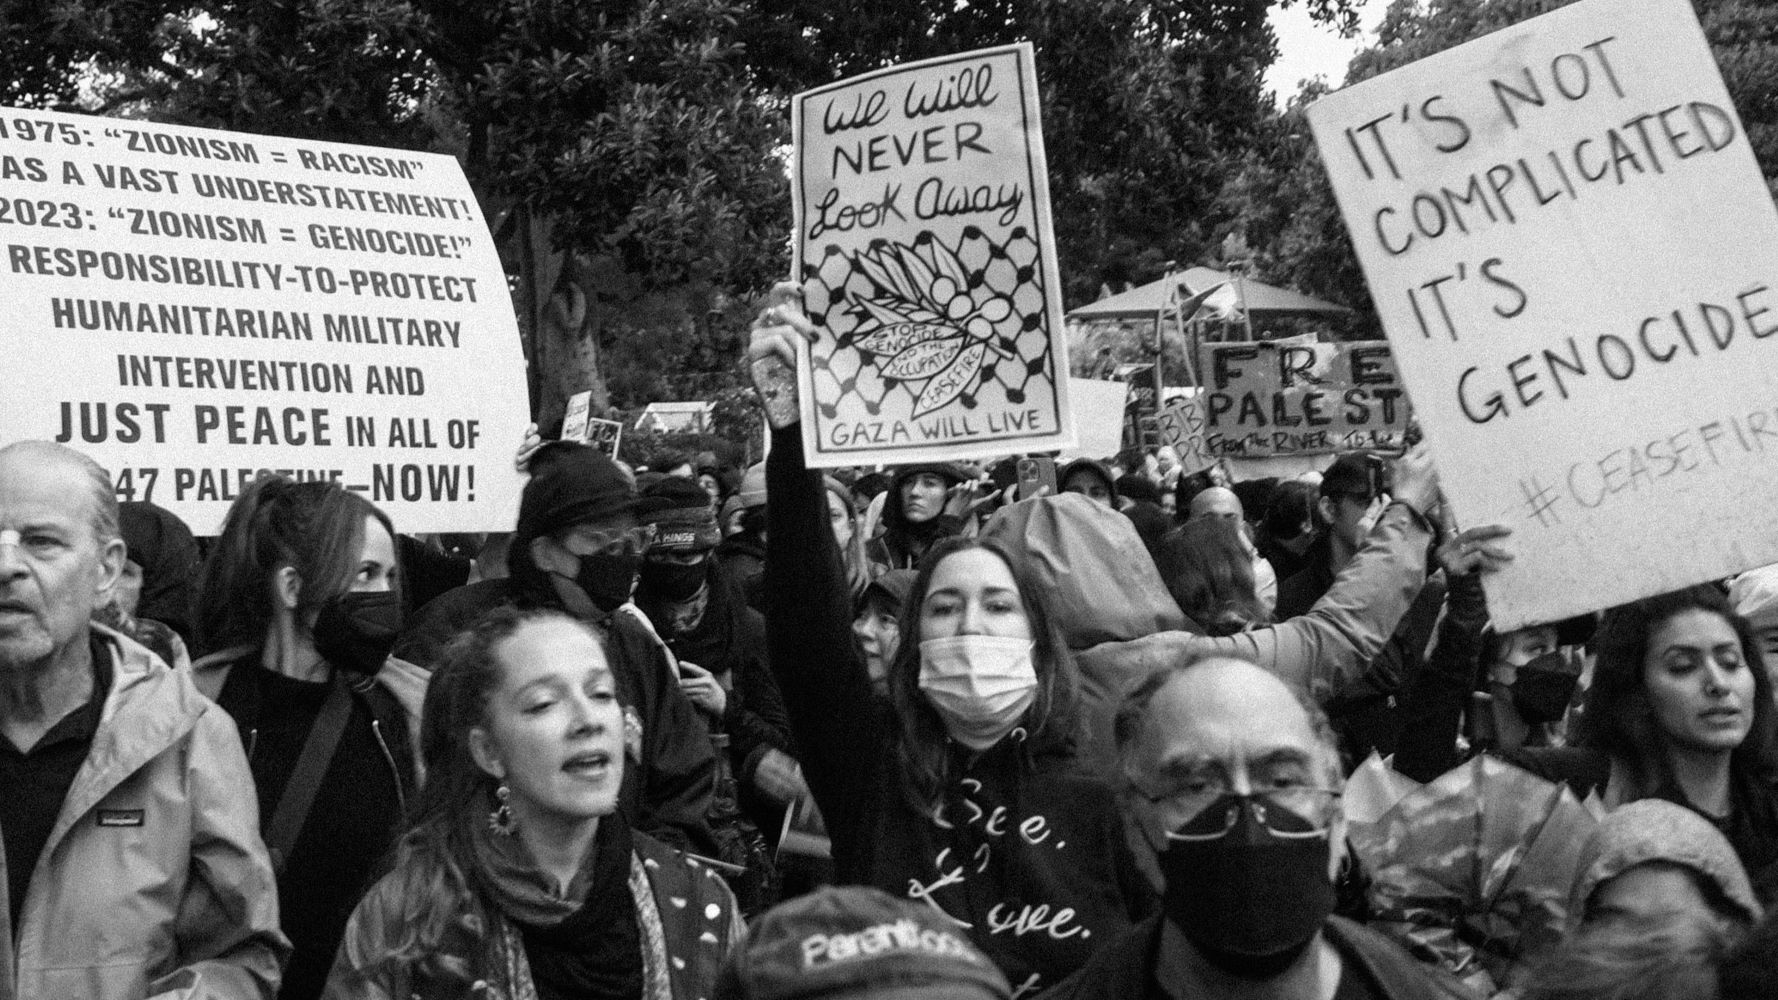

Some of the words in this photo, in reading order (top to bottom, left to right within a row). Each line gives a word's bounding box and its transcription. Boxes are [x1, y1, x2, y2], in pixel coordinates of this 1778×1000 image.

[824, 90, 890, 135] We
[904, 63, 999, 119] Will
[1345, 95, 1470, 180] IT'S
[1490, 36, 1616, 129] NOT
[0, 117, 94, 148] 1975:
[104, 127, 260, 164] “ZIONISM
[298, 149, 424, 180] RACISM”
[832, 121, 993, 180] NEVER
[1375, 101, 1736, 256] COMPLICATED
[2, 155, 48, 182] AS
[62, 161, 85, 186] A
[93, 164, 180, 194] VAST
[191, 173, 473, 221] UNDERSTATEMENT!
[915, 177, 1023, 226] Away
[0, 197, 97, 231] 2023:
[108, 206, 268, 245] “ZIONISM
[308, 222, 473, 260] GENOCIDE!”
[8, 244, 478, 303] RESPONSIBILITY-TO-PROTECT
[1407, 257, 1527, 342] IT'S
[52, 297, 314, 341] HUMANITARIAN
[324, 313, 461, 348] MILITARY
[117, 354, 354, 394] INTERVENTION
[365, 365, 425, 396] AND
[920, 349, 982, 409] CEASEFIRE
[1457, 286, 1778, 423] GENOCIDE
[56, 401, 170, 444] JUST
[194, 404, 331, 447] PEACE
[347, 415, 375, 448] IN
[388, 417, 438, 449] ALL
[447, 419, 480, 449] OF
[830, 420, 910, 447] GAZA
[919, 414, 979, 440] WILL
[988, 408, 1041, 433] LIVE
[102, 467, 160, 502] 47
[1518, 406, 1778, 528] #CEASEFIR
